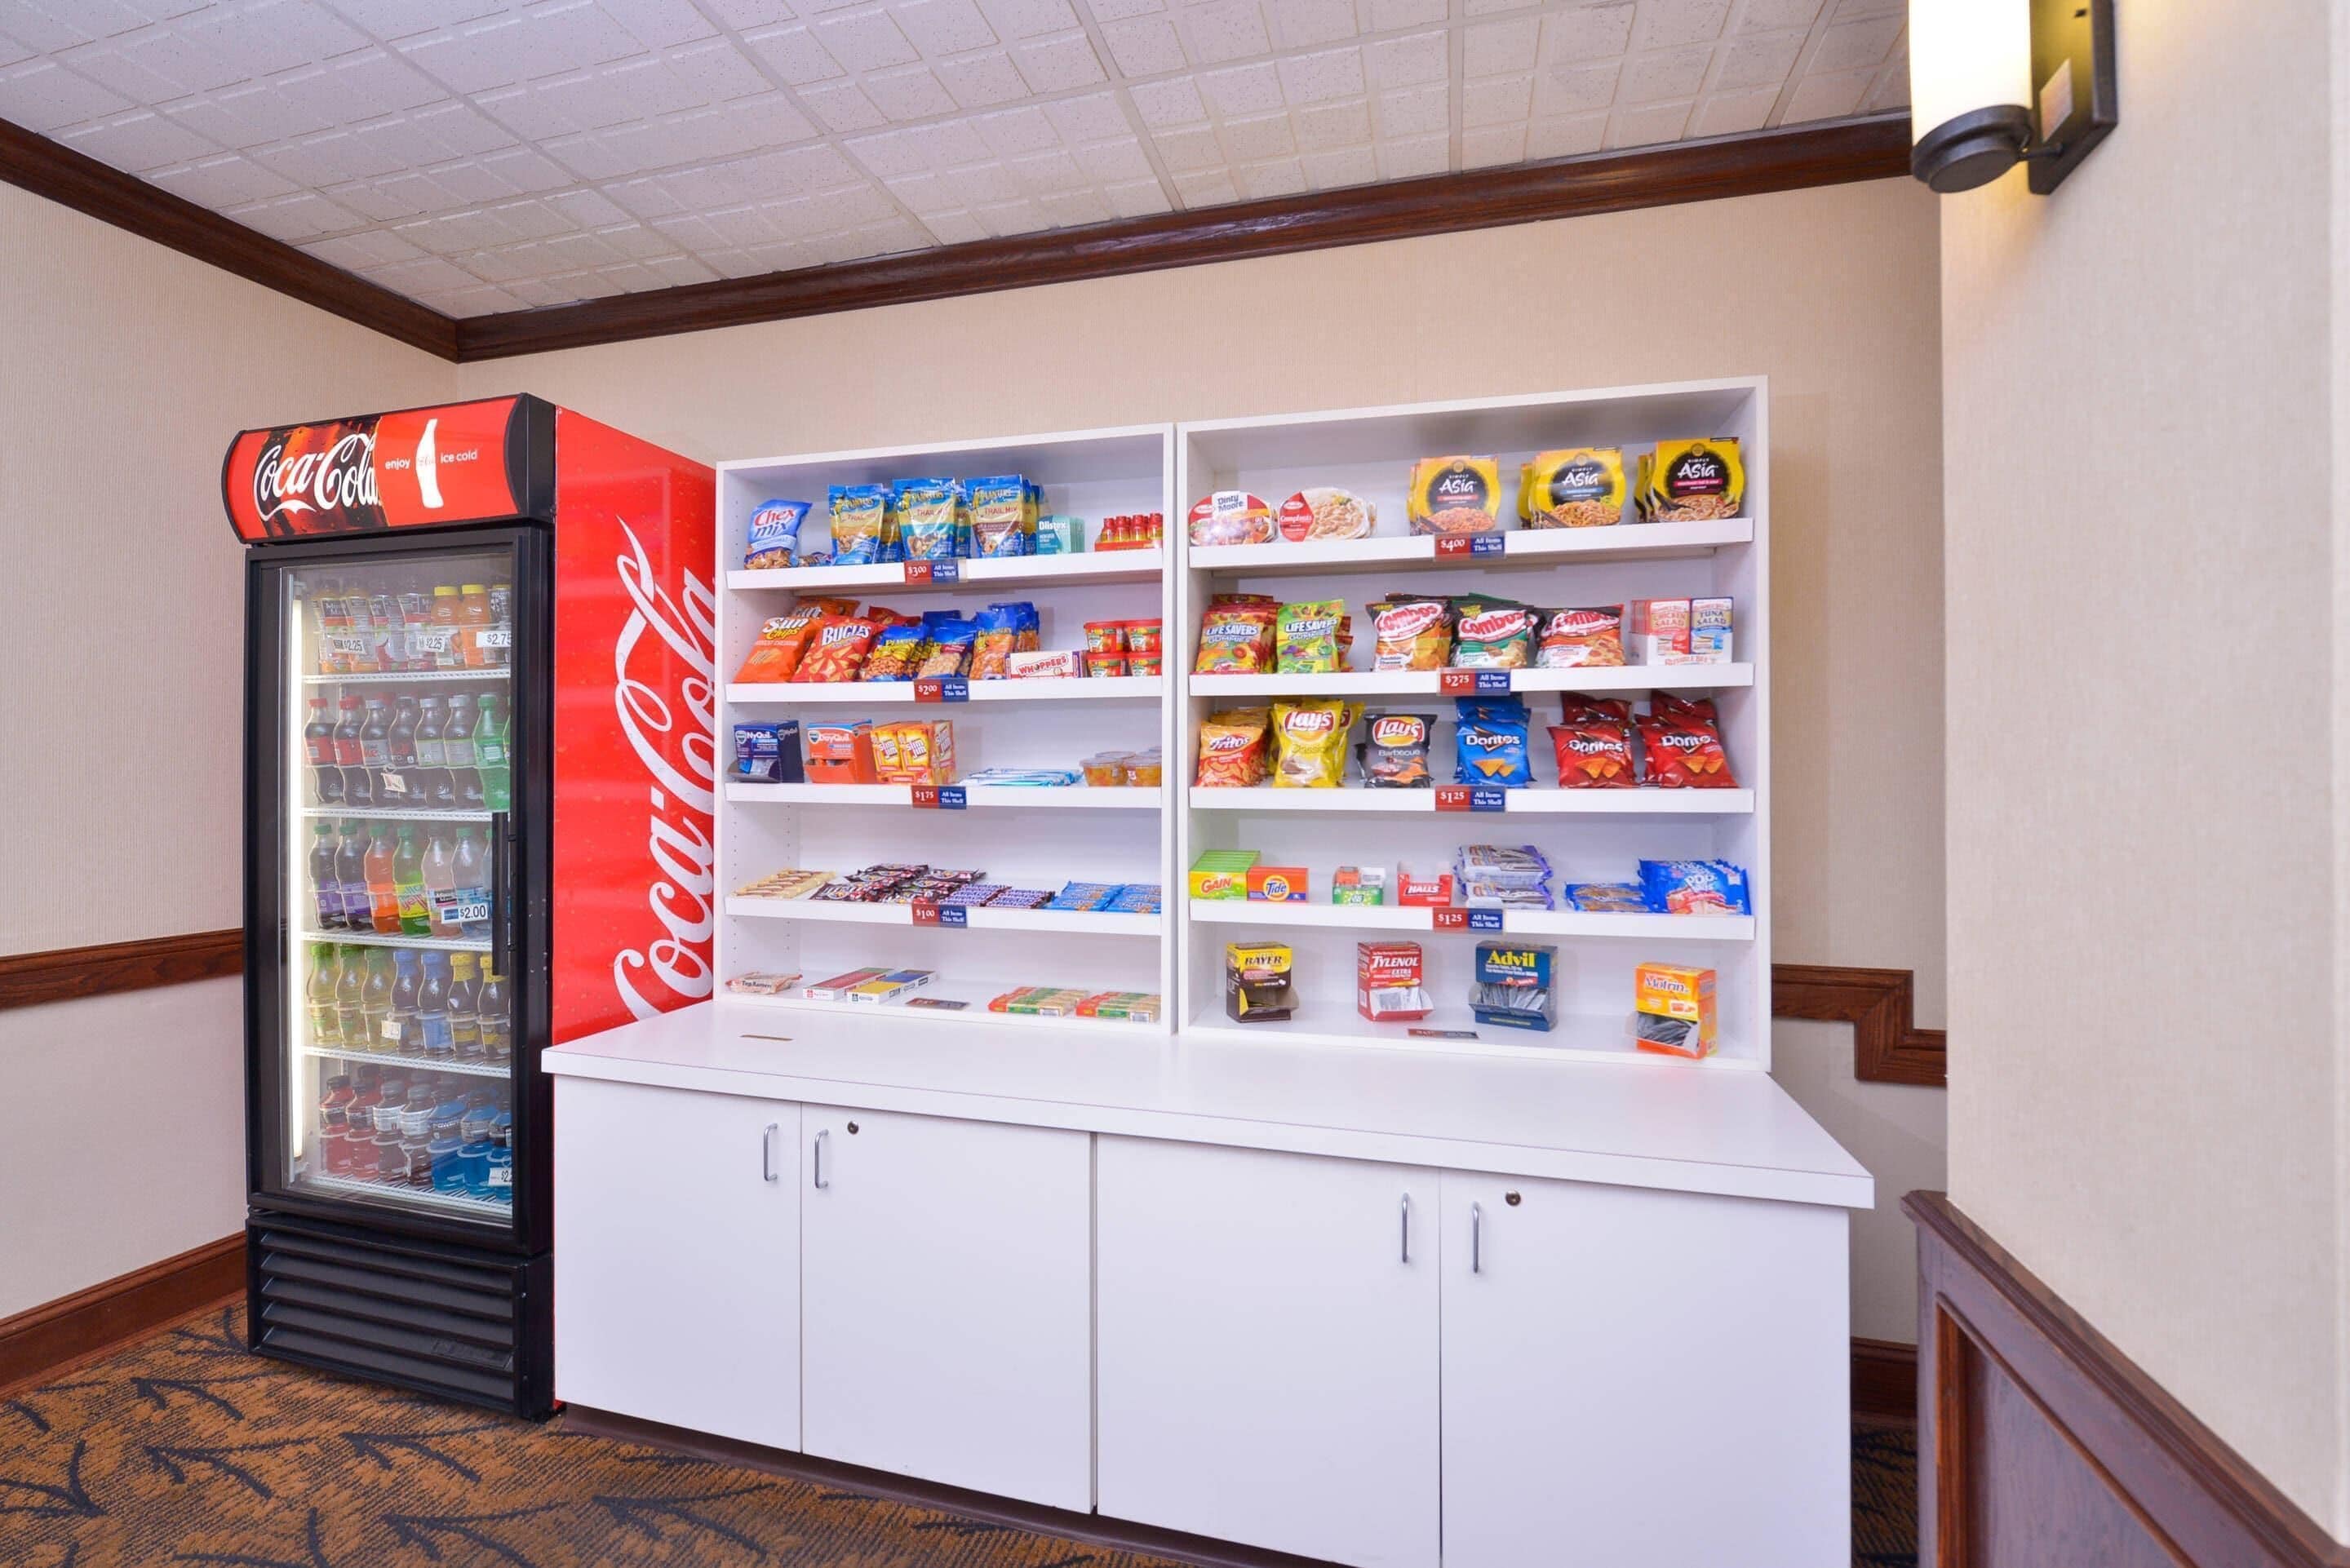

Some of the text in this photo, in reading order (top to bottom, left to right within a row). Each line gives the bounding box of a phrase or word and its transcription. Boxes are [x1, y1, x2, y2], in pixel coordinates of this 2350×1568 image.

[441, 453, 454, 462] ice
[456, 450, 477, 461] cold
[385, 458, 410, 470] enjoy
[1678, 463, 1716, 478] Asia
[254, 432, 382, 521] Coca-Cola
[1562, 472, 1599, 487] Asia
[1439, 479, 1475, 494] Asia
[1217, 494, 1239, 505] Dinty
[1218, 500, 1244, 512] Moore
[754, 508, 796, 527] Chex
[762, 618, 809, 633] Sun
[1225, 624, 1258, 635] SAVERS
[1285, 621, 1305, 632] LIFE
[1461, 612, 1524, 635] Combos
[1018, 655, 1067, 675] WHOPPERS
[1466, 734, 1520, 746] Doritos
[1569, 739, 1624, 753] Doritos
[1661, 734, 1716, 747] Dorito
[1200, 878, 1233, 893] GAIN
[1266, 882, 1287, 895] Tide
[1408, 885, 1440, 894] HALLS
[459, 905, 487, 919] $2.00
[1245, 956, 1282, 965] BAYER
[1371, 955, 1419, 972] TYLENOL
[1488, 950, 1536, 968] Advil
[1645, 978, 1685, 993] Motrin
